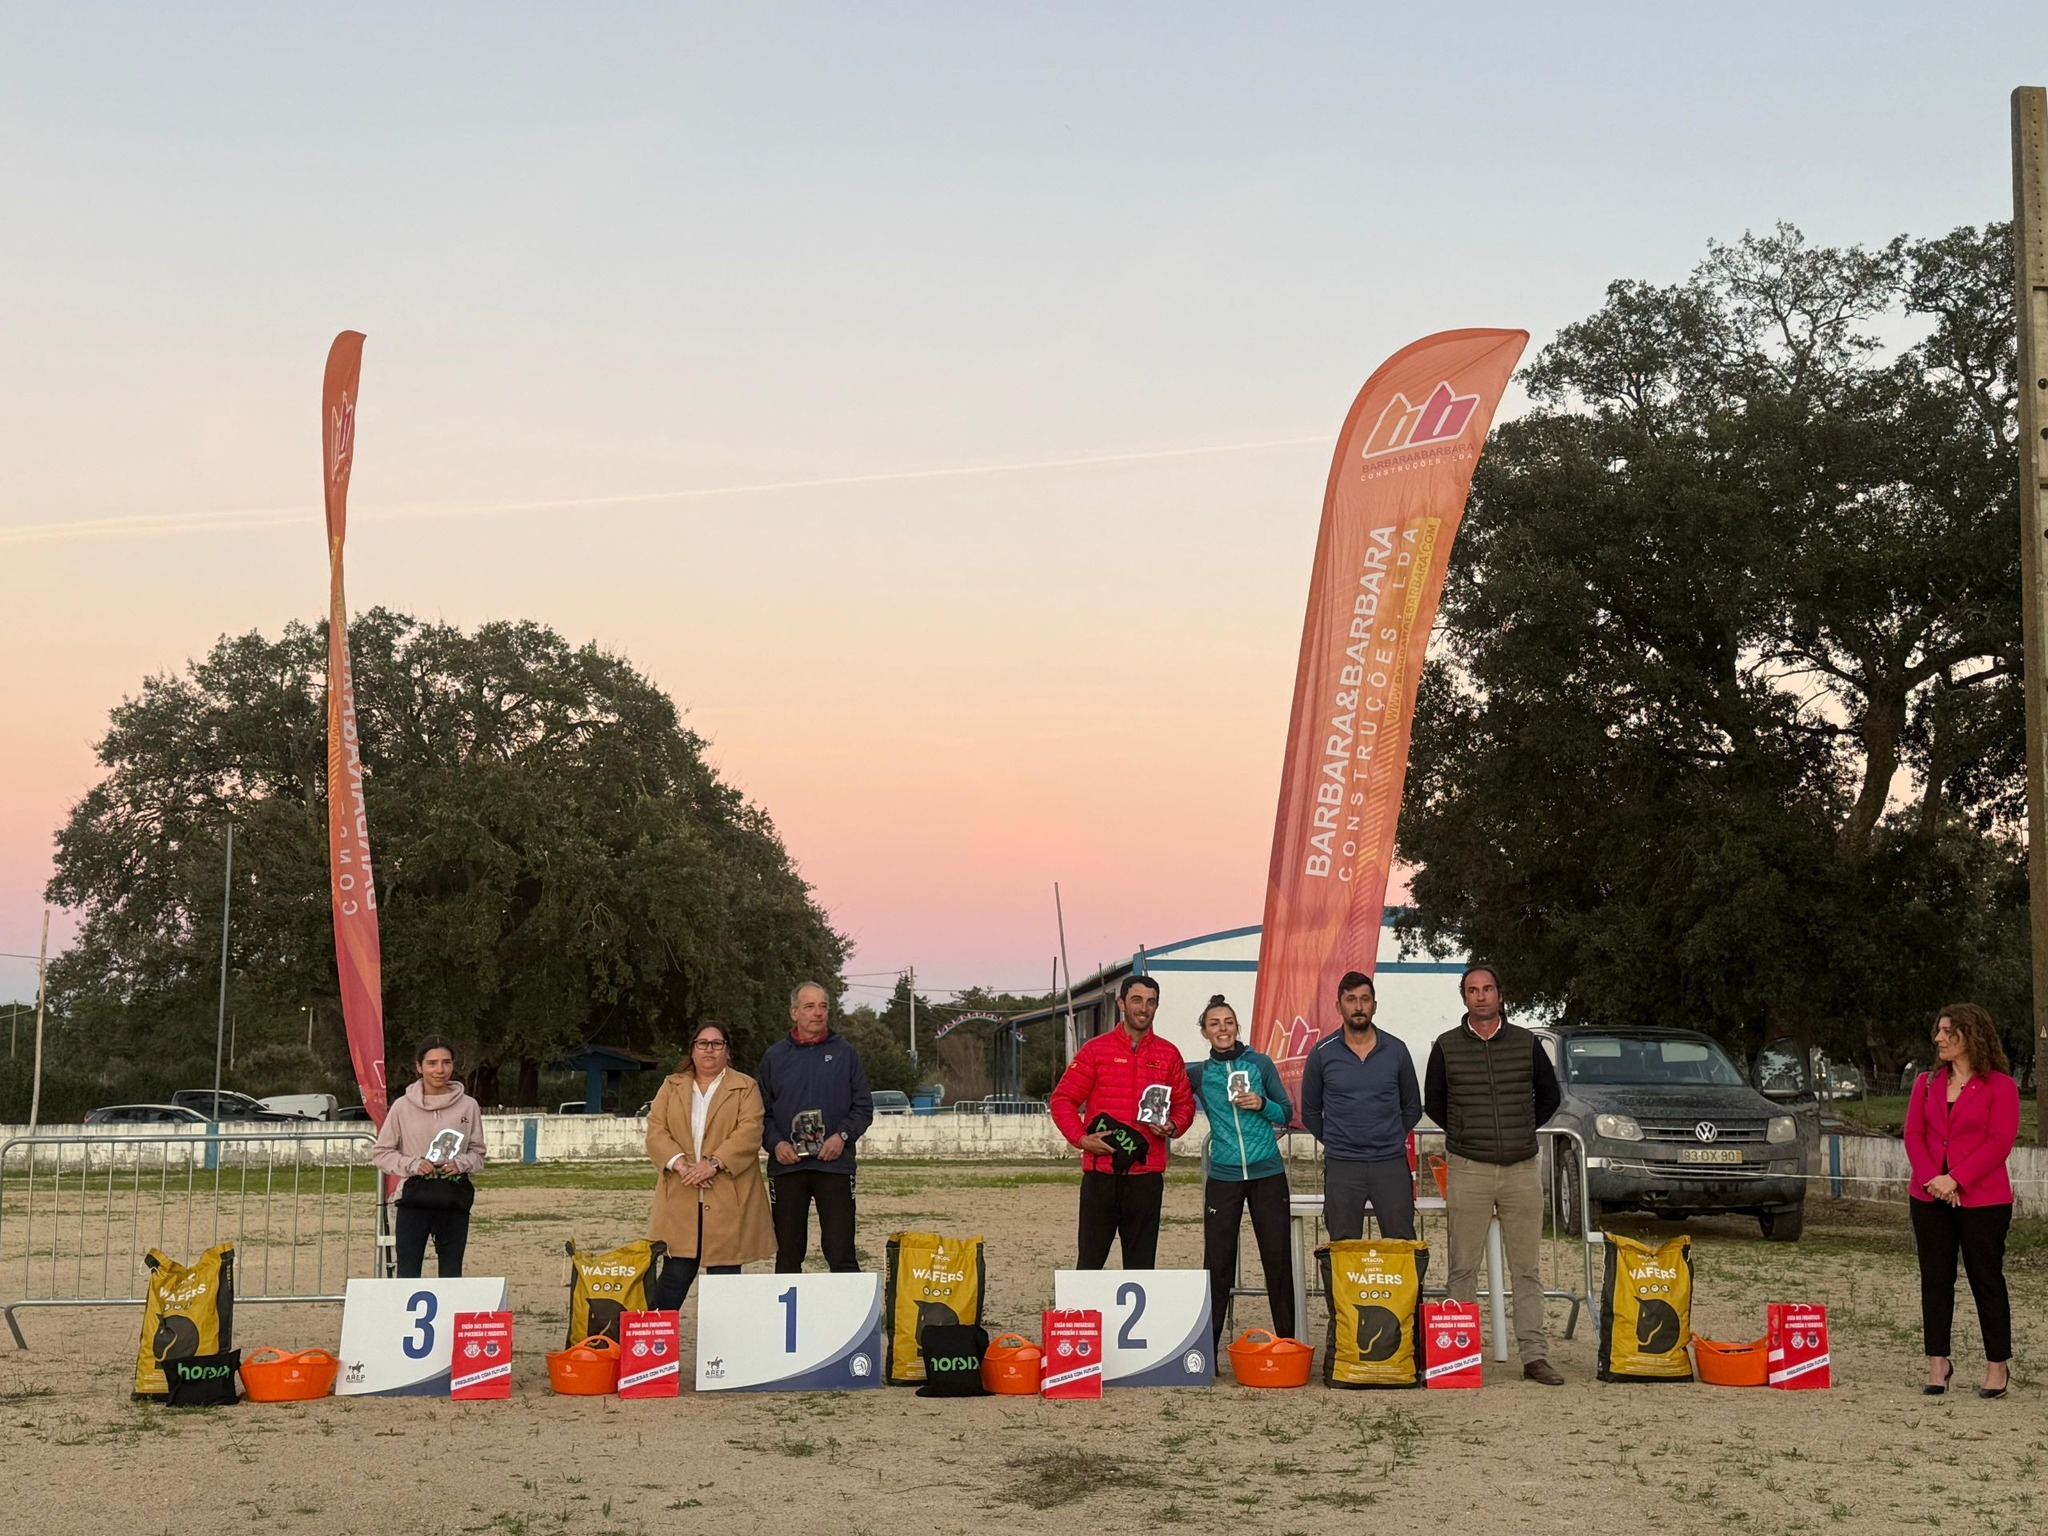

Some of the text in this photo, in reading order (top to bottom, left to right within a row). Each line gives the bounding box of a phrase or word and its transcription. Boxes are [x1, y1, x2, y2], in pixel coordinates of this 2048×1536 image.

[1361, 442, 1474, 474] BARBARA&BARBARA
[1394, 527, 1419, 590] LDA
[1305, 525, 1397, 877] BARBARA&BARBARA
[1141, 1108, 1153, 1122] 2
[431, 1149, 442, 1162] 3
[581, 1264, 636, 1277] WAFERS
[912, 1268, 964, 1284] WAFERS
[1346, 1271, 1403, 1285] WAFERS
[402, 1290, 439, 1360] 3
[778, 1286, 797, 1353] 1
[1116, 1282, 1148, 1350] 2
